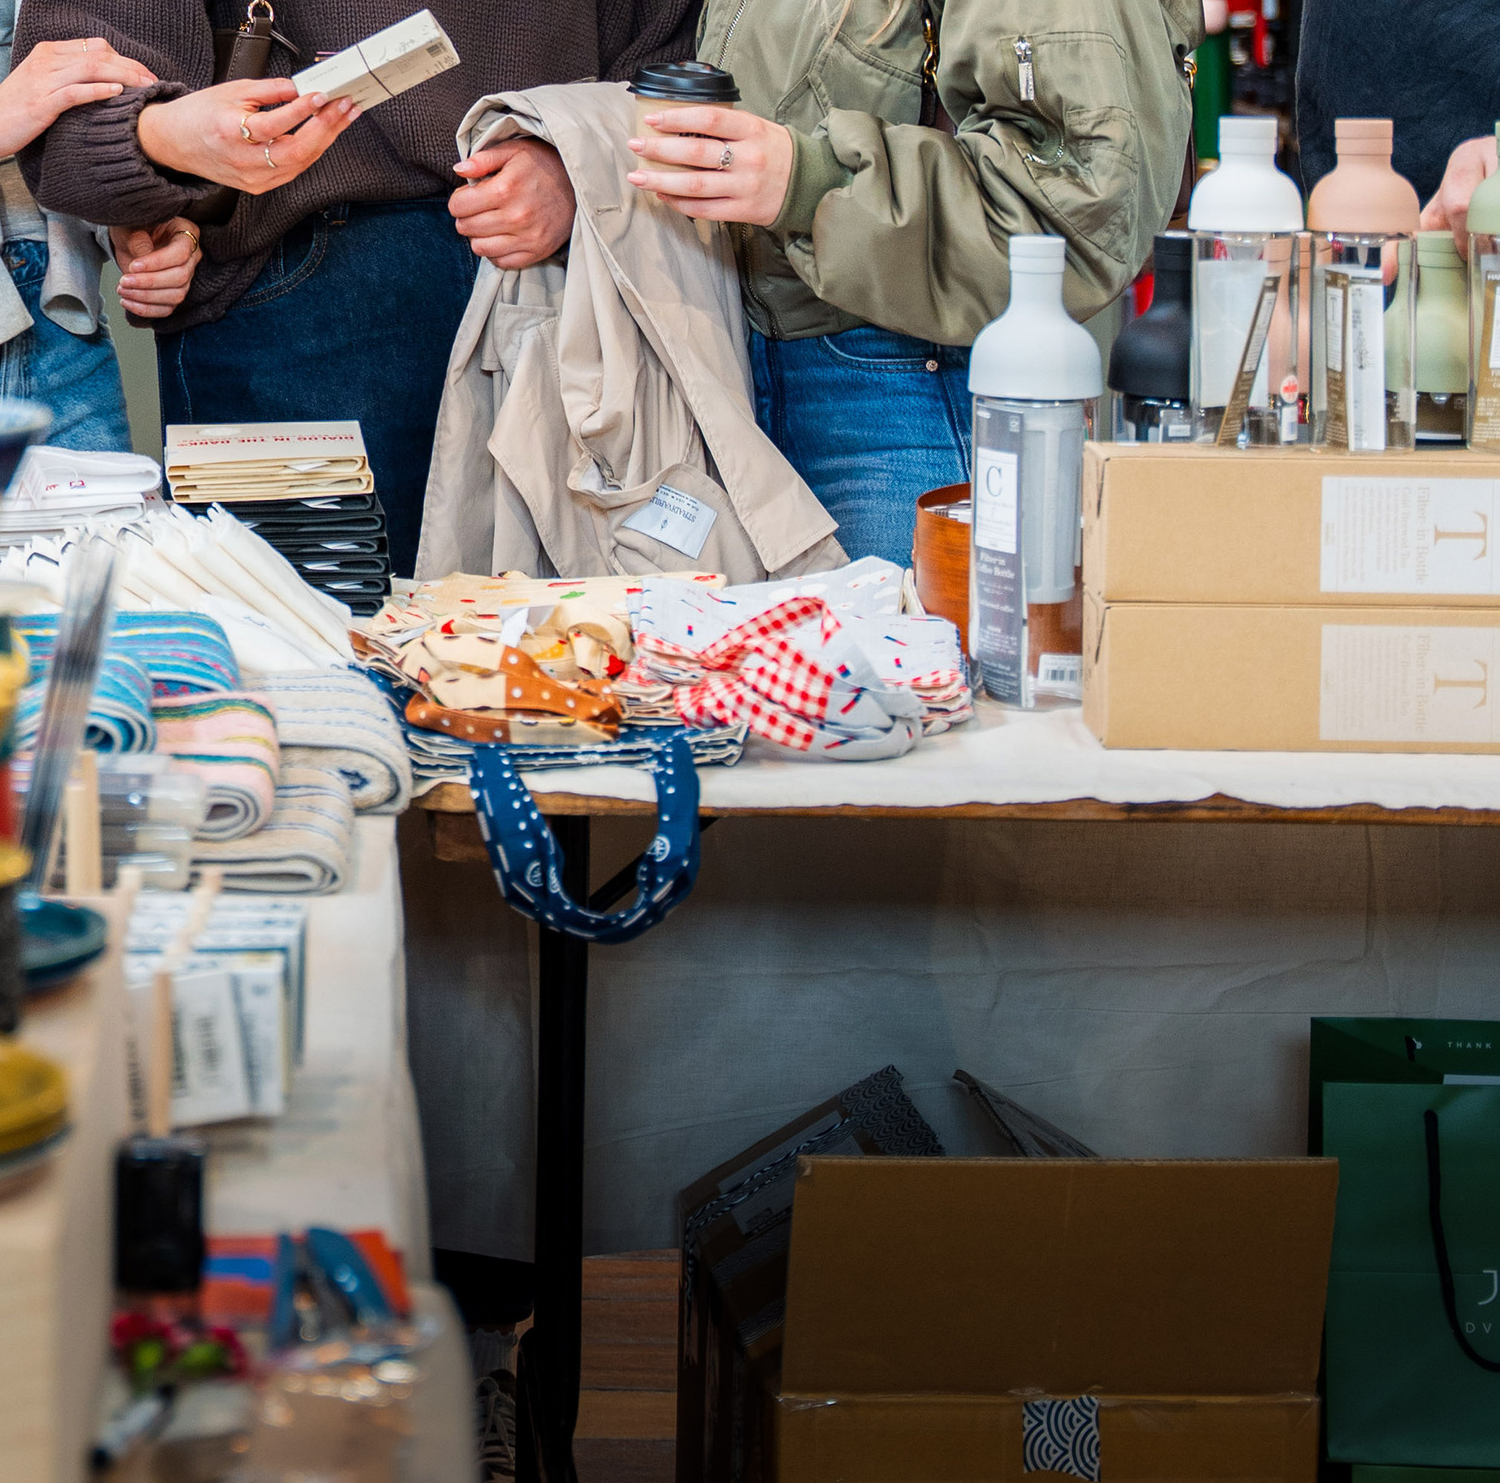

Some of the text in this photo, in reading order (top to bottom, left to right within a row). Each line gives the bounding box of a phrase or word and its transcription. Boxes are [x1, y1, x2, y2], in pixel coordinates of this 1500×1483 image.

[986, 465, 1002, 497] C
[1434, 510, 1488, 561] T
[1434, 659, 1488, 710] T
[1447, 1041, 1492, 1049] THANK
